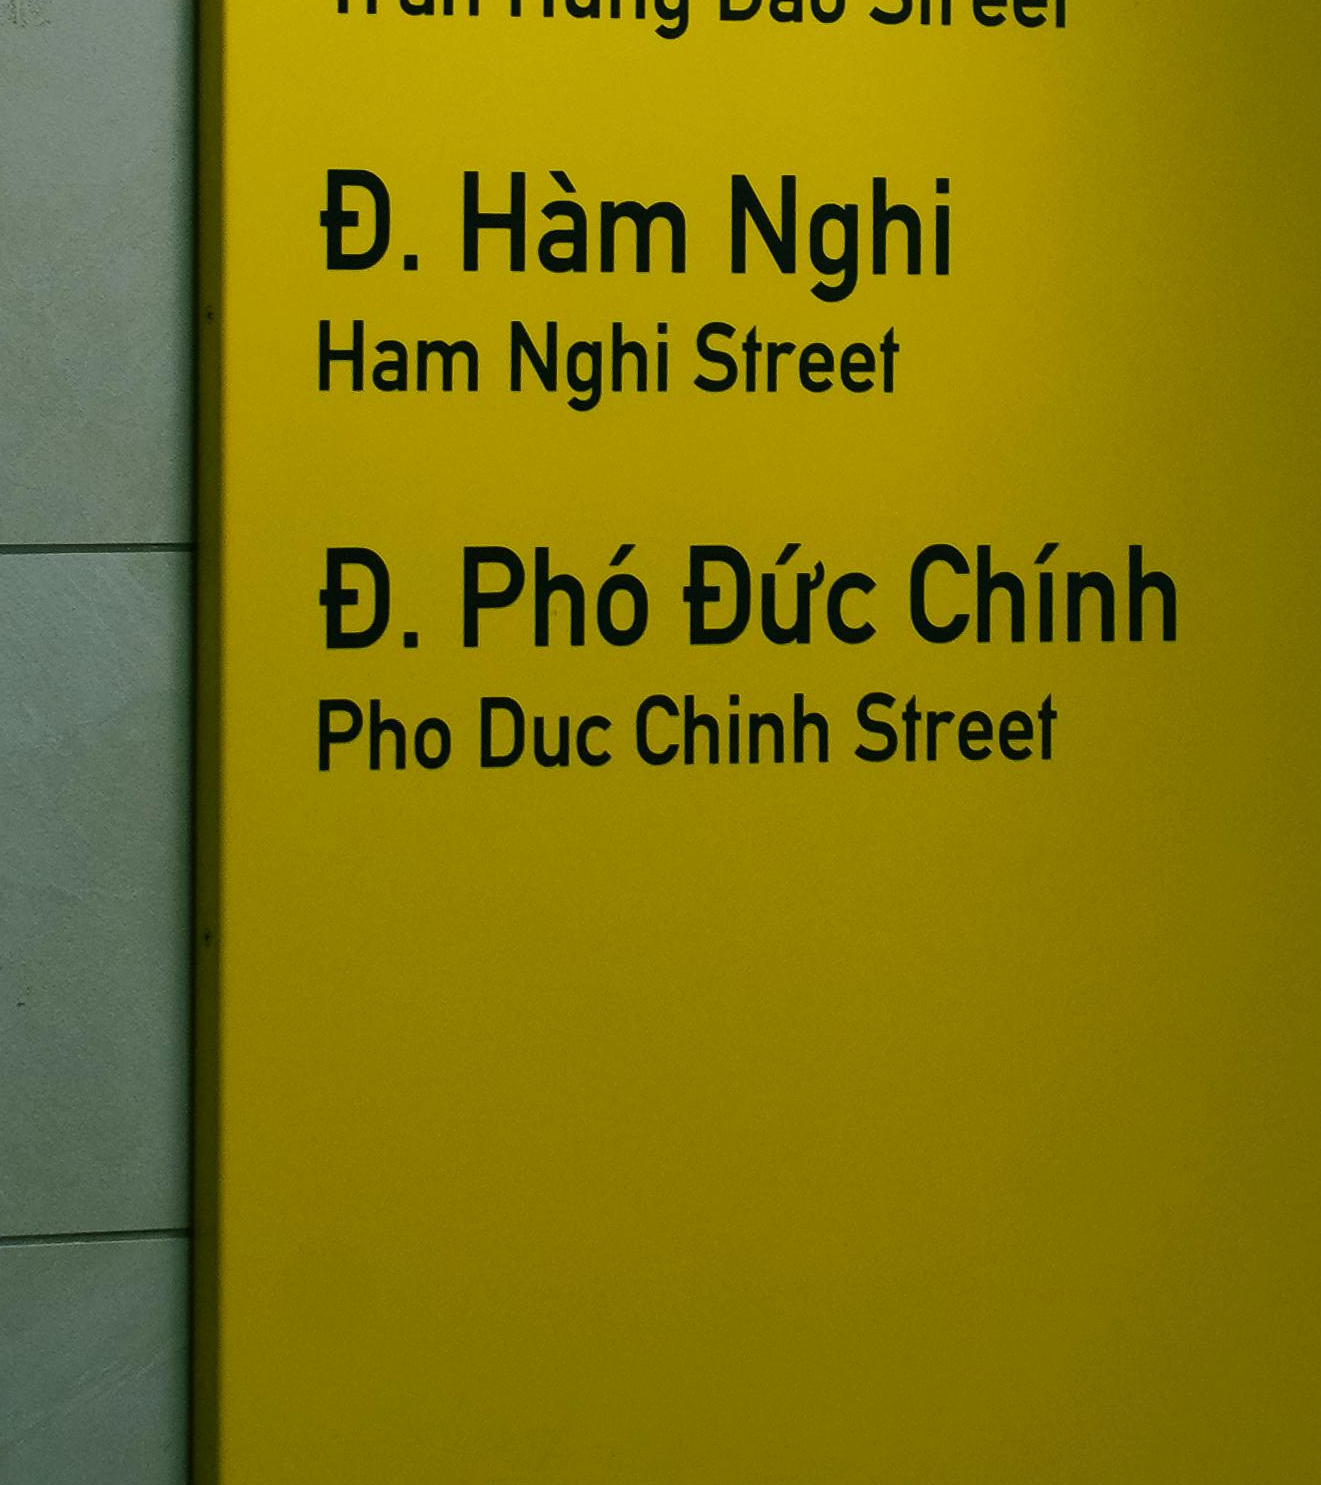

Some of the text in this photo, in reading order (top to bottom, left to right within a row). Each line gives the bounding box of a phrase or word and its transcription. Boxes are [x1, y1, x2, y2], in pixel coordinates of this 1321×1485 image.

[320, 169, 951, 303] Đ. Hàm Nghi
[318, 319, 900, 412] Ham Nghi Street
[319, 542, 1179, 650] Đ. Phó Đức Chính
[318, 692, 1058, 772] Pho Duc Chinh Street
